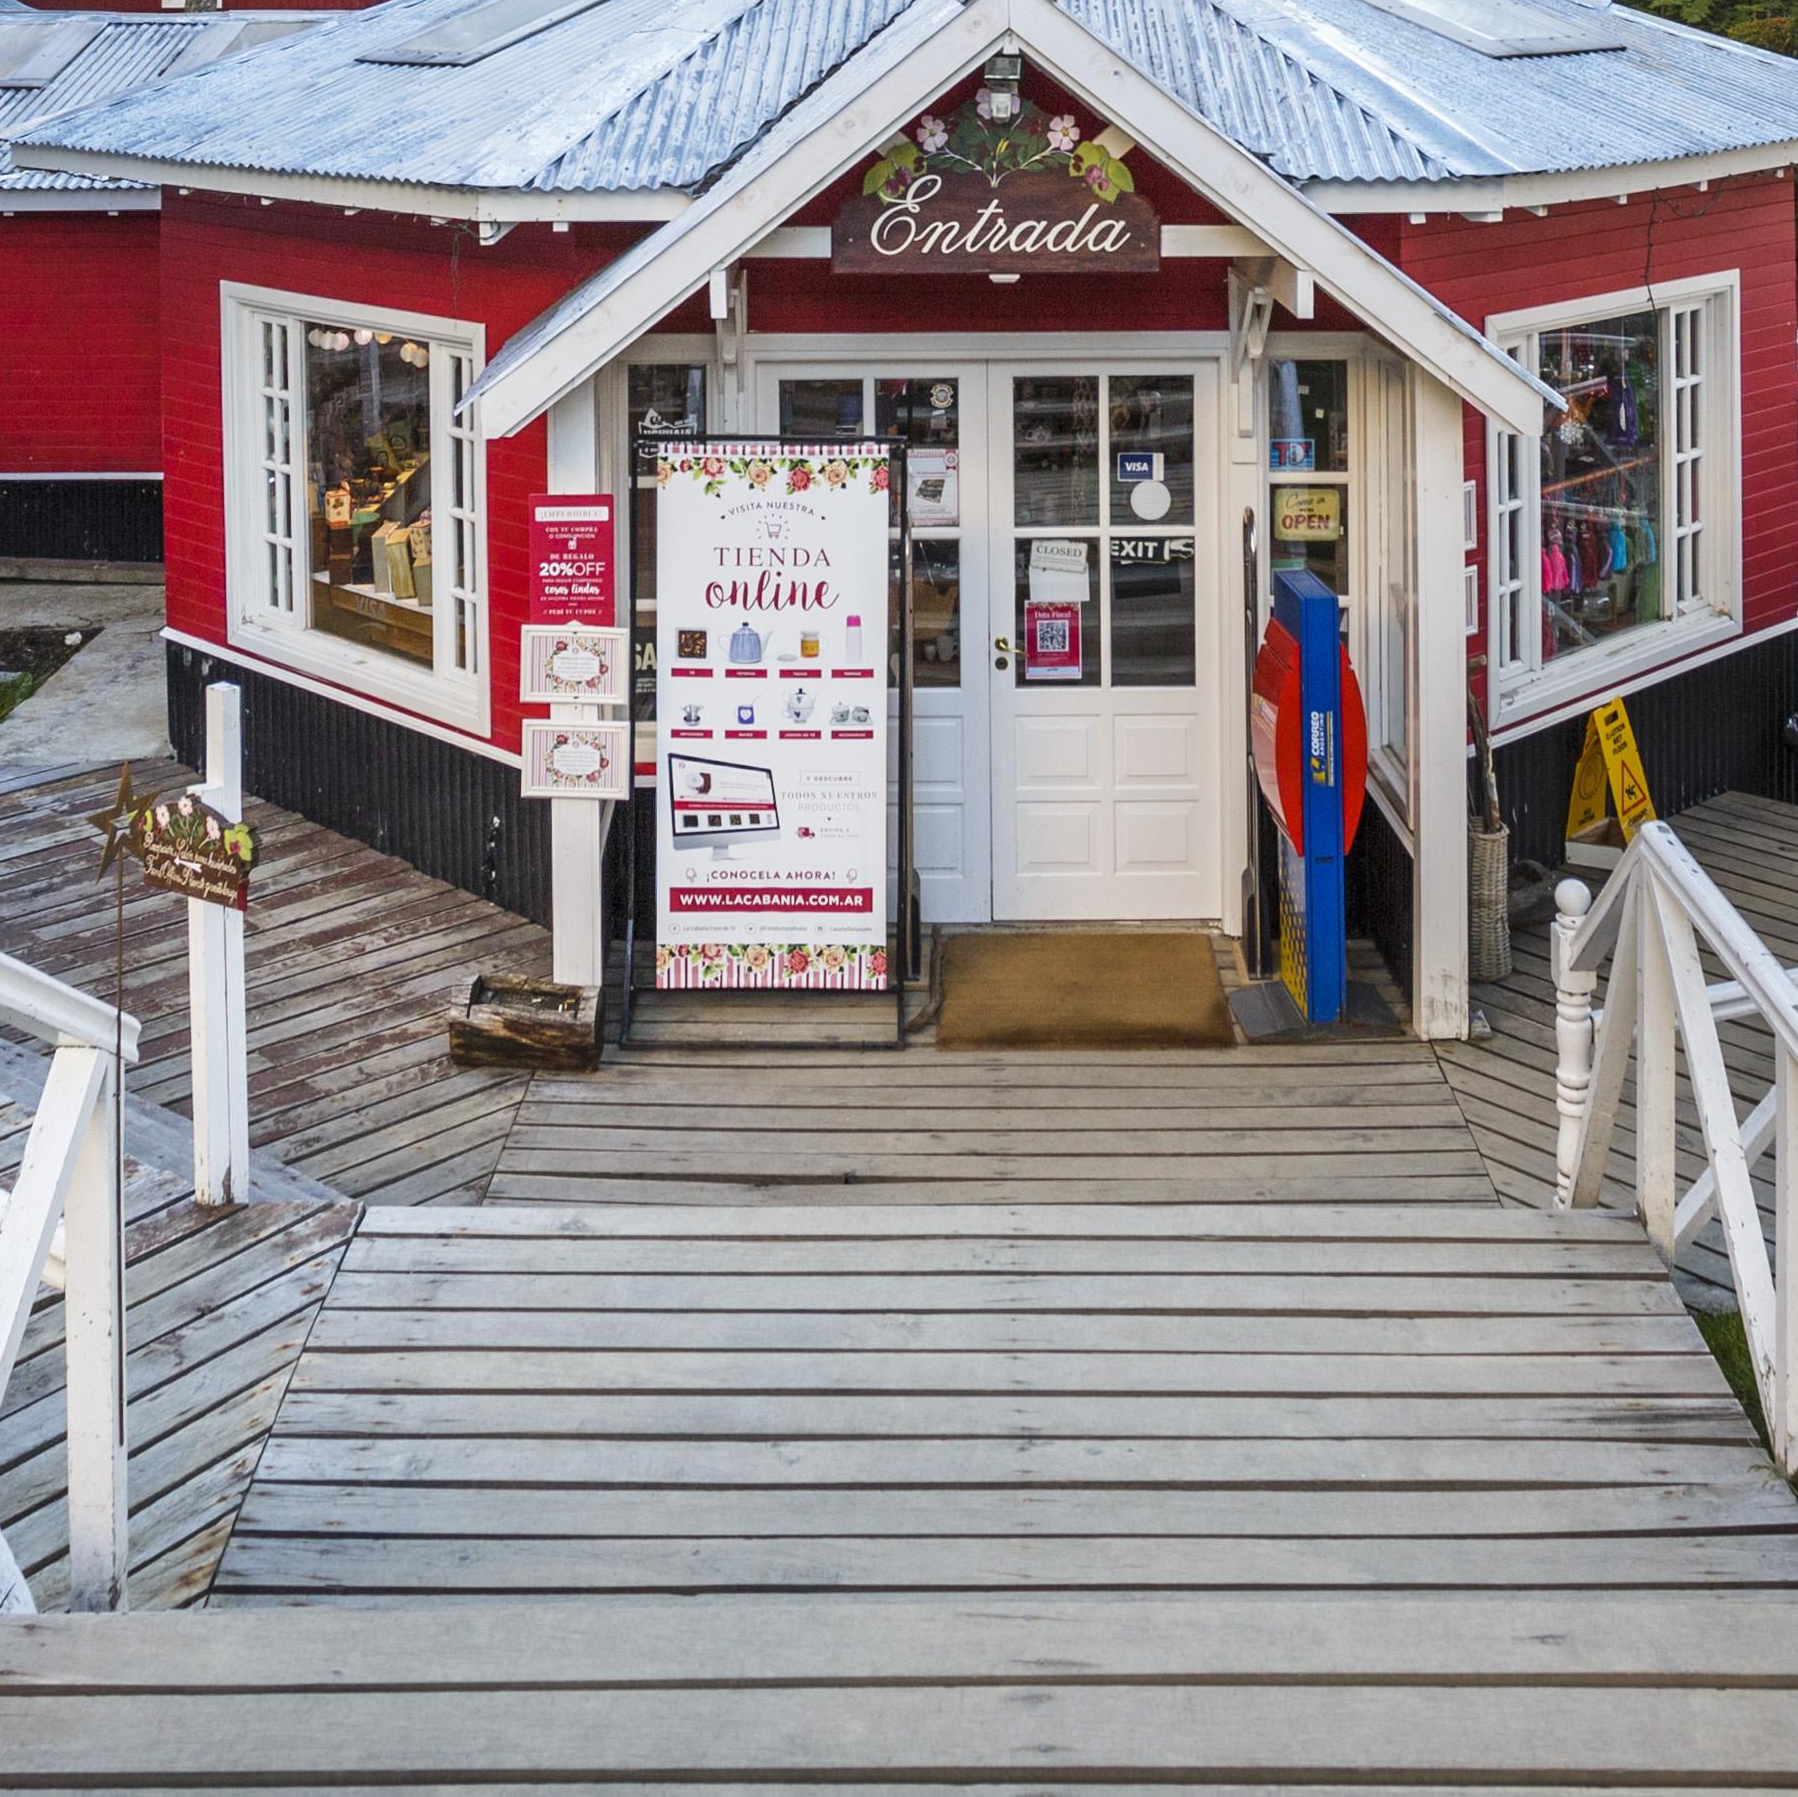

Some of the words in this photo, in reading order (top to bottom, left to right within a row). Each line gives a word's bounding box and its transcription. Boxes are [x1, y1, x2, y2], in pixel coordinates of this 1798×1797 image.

[870, 174, 1131, 255] Entrada
[1124, 462, 1149, 472] VISA
[1286, 494, 1314, 508] Come
[728, 502, 762, 516] VISITA
[767, 501, 815, 516] NUESTRA
[1281, 514, 1330, 530] OPEN
[1036, 545, 1082, 558] CLOSED
[1111, 540, 1158, 558] EXIT
[713, 547, 831, 567] TIENDA
[539, 562, 605, 576] 20%OFF
[545, 585, 569, 595] cosas
[571, 583, 600, 595] lindas
[706, 570, 840, 611] online
[355, 595, 386, 620] VISA
[1310, 711, 1320, 756] CORREO
[1613, 733, 1623, 745] WET
[1612, 740, 1628, 755] FLOOR
[781, 791, 817, 799] TODOS
[821, 791, 878, 800] NUESTROS
[798, 803, 861, 812] PRODUCTOS
[706, 870, 781, 882] ¡CONOCELA
[785, 870, 836, 880] AHORA!
[679, 893, 863, 907] WWW.LACABANIA.COM.AR
